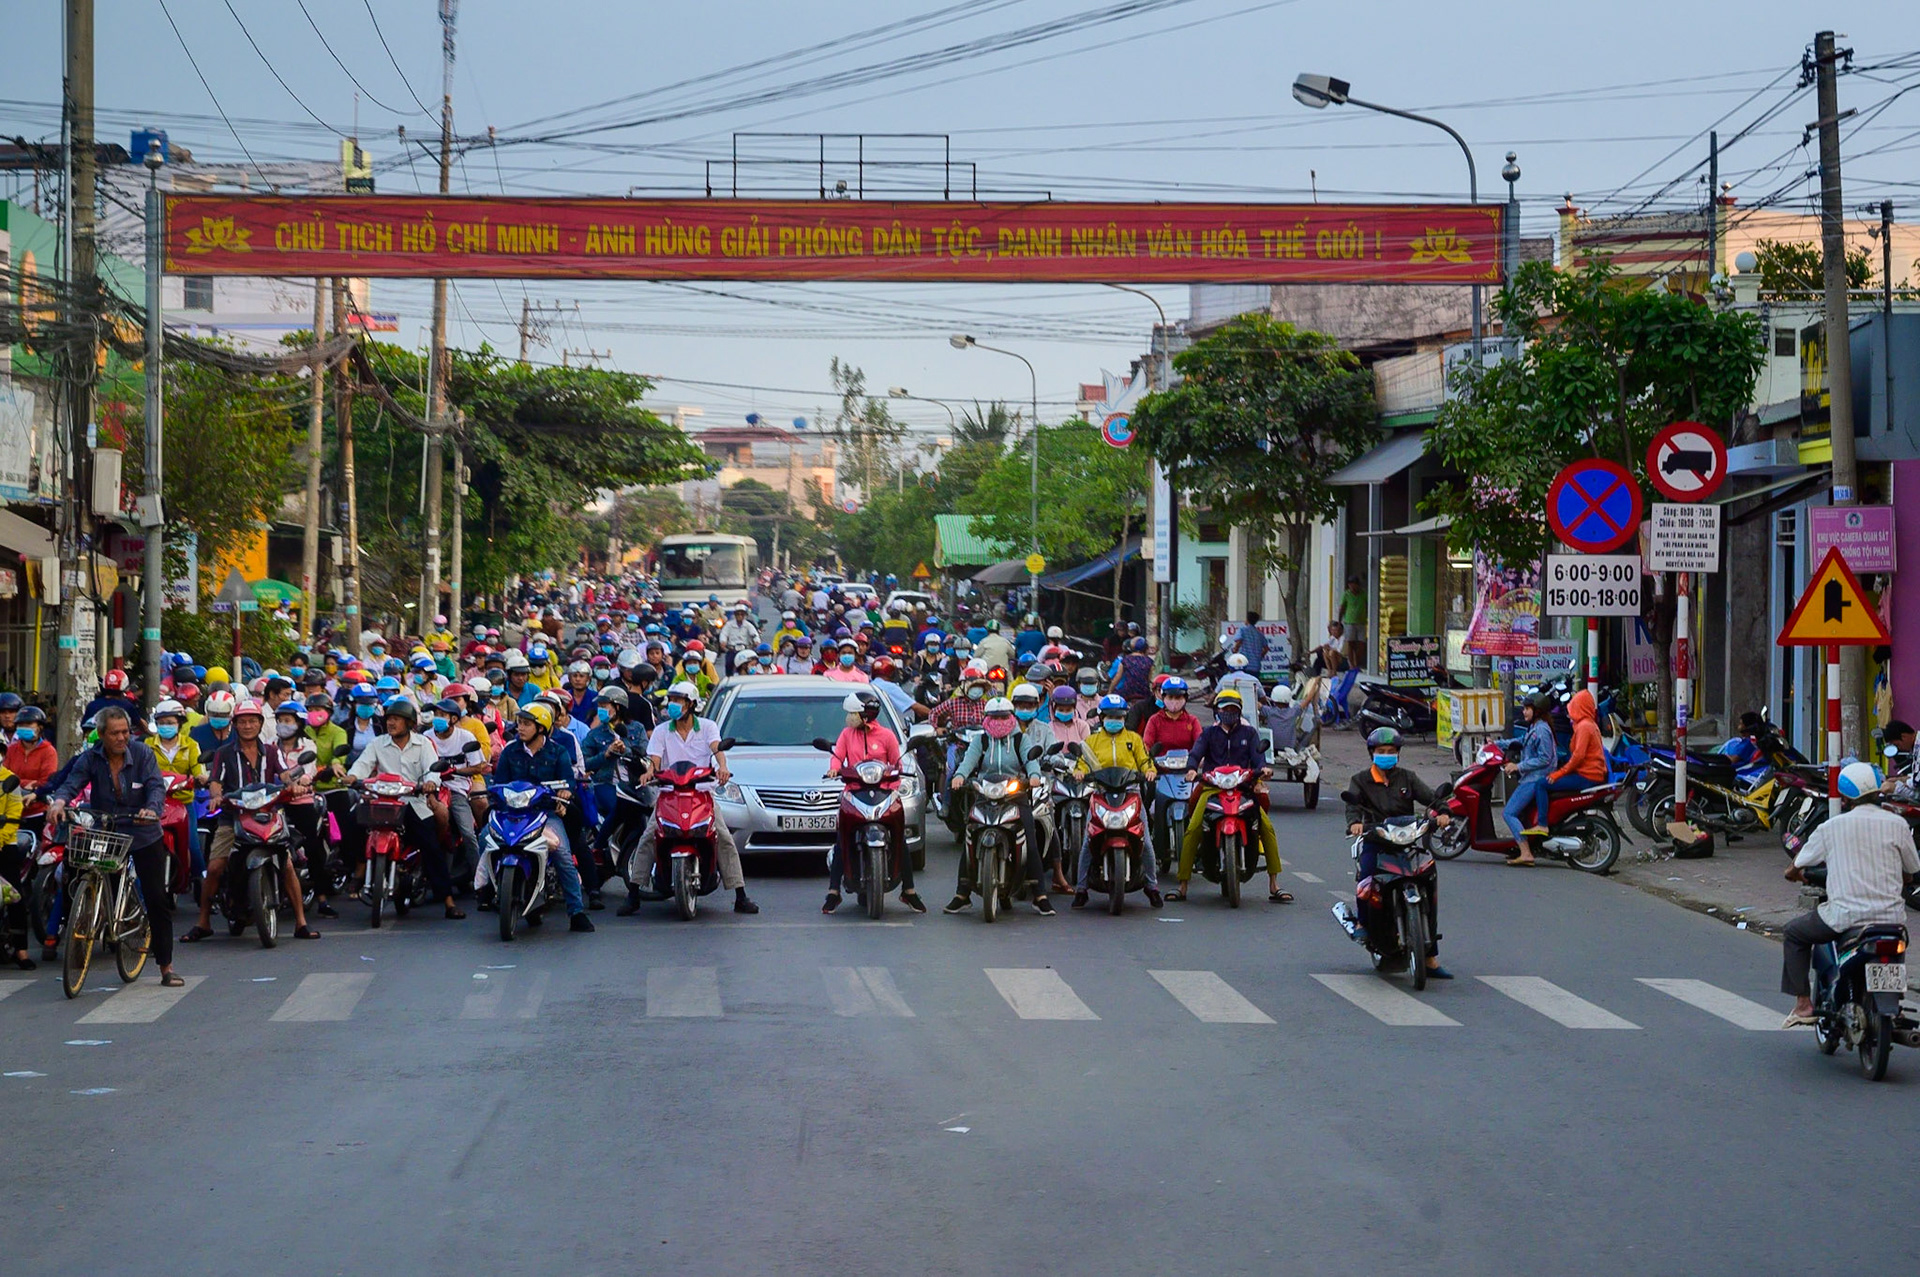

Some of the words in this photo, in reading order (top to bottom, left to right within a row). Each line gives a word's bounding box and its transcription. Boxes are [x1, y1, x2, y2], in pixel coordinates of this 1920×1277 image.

[275, 212, 325, 252] CHỦ
[335, 222, 392, 261] TỊCH
[402, 211, 437, 253] HỒ
[446, 218, 487, 253] CHÍ
[497, 224, 558, 254] MINH
[585, 225, 635, 254] ANH
[645, 218, 711, 255] HÙNG
[720, 215, 769, 257] GIẢI
[779, 217, 863, 257] PHÓNG
[872, 219, 921, 257] DÂN
[998, 227, 1062, 258] DANH
[1071, 220, 1137, 259] NHÂN
[1146, 222, 1192, 259] VĂN
[1201, 221, 1249, 259] HÓA
[1260, 216, 1306, 259] THẾ
[1315, 220, 1365, 260] GIỚI
[1680, 507, 1694, 516] 6h30
[1699, 507, 1712, 517] 7h30
[1678, 518, 1694, 527] 16h30
[1699, 518, 1715, 527] 17h30
[1816, 532, 1828, 544] KHU
[1840, 532, 1863, 543] CAMERA
[1863, 531, 1878, 542] QUAN
[1878, 529, 1889, 542] SÁT
[1548, 588, 1639, 607] 15:00-18:00
